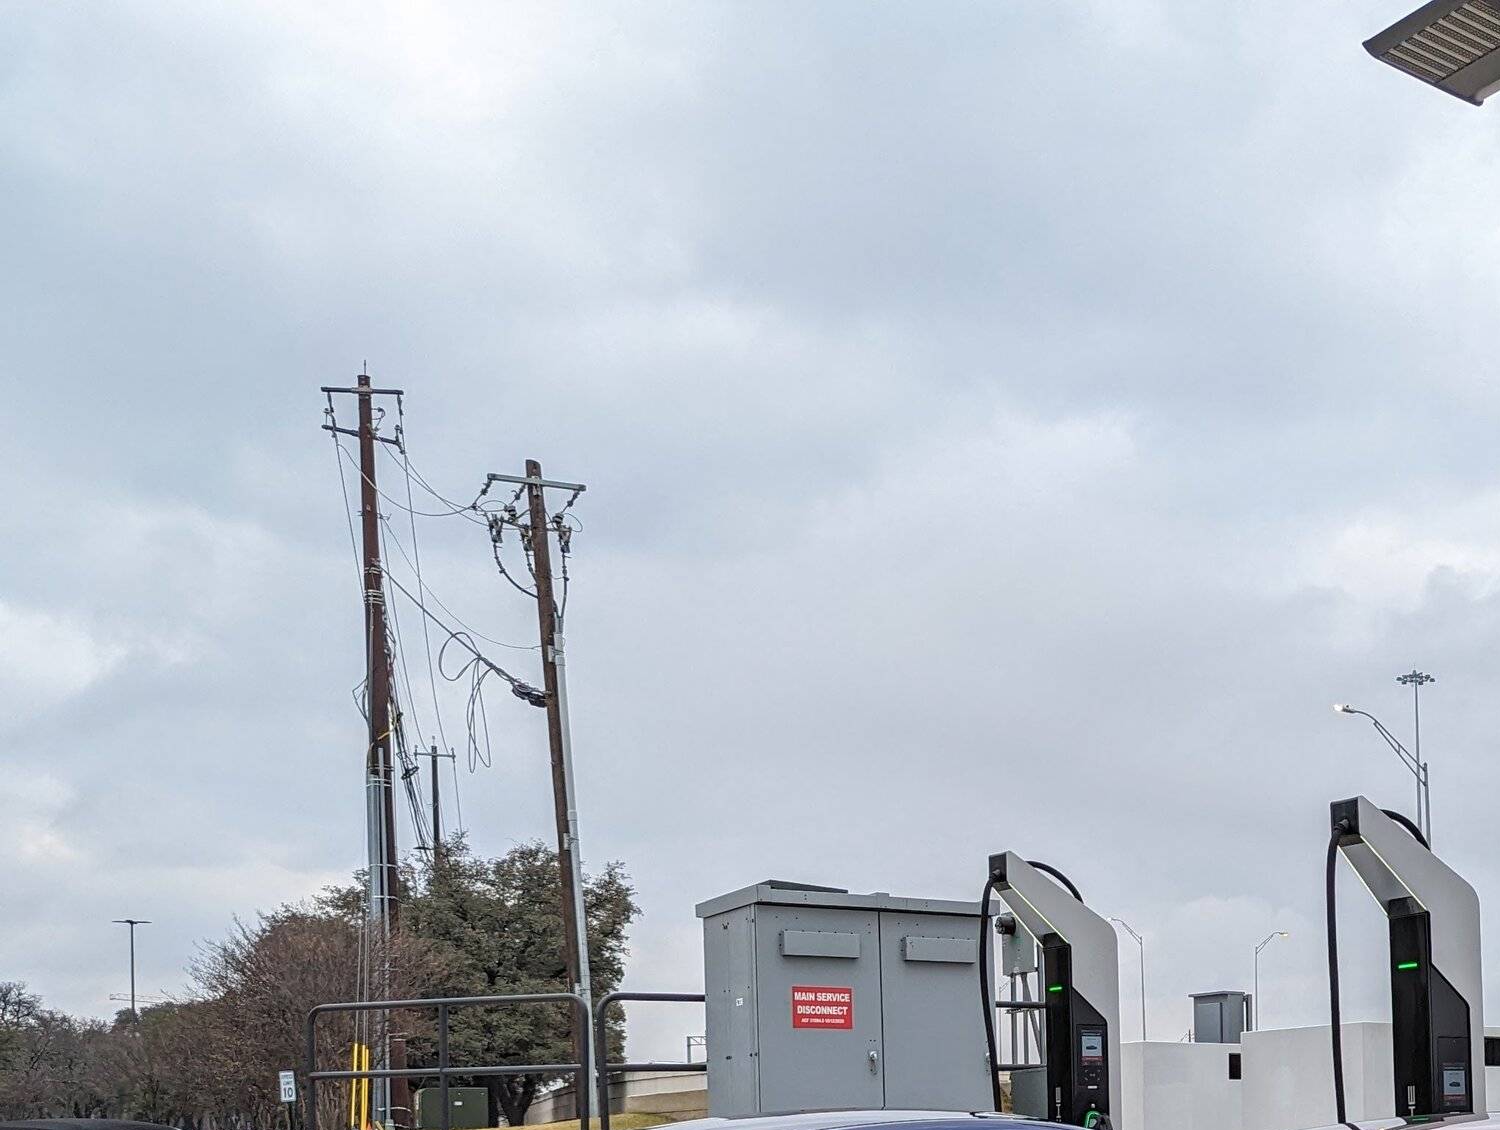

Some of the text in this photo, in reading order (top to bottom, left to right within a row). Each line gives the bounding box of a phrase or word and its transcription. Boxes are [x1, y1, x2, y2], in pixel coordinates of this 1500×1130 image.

[794, 991, 850, 1002] MAIN SERVICE
[797, 1005, 848, 1016] DISCONNECT
[283, 1087, 294, 1098] 10
